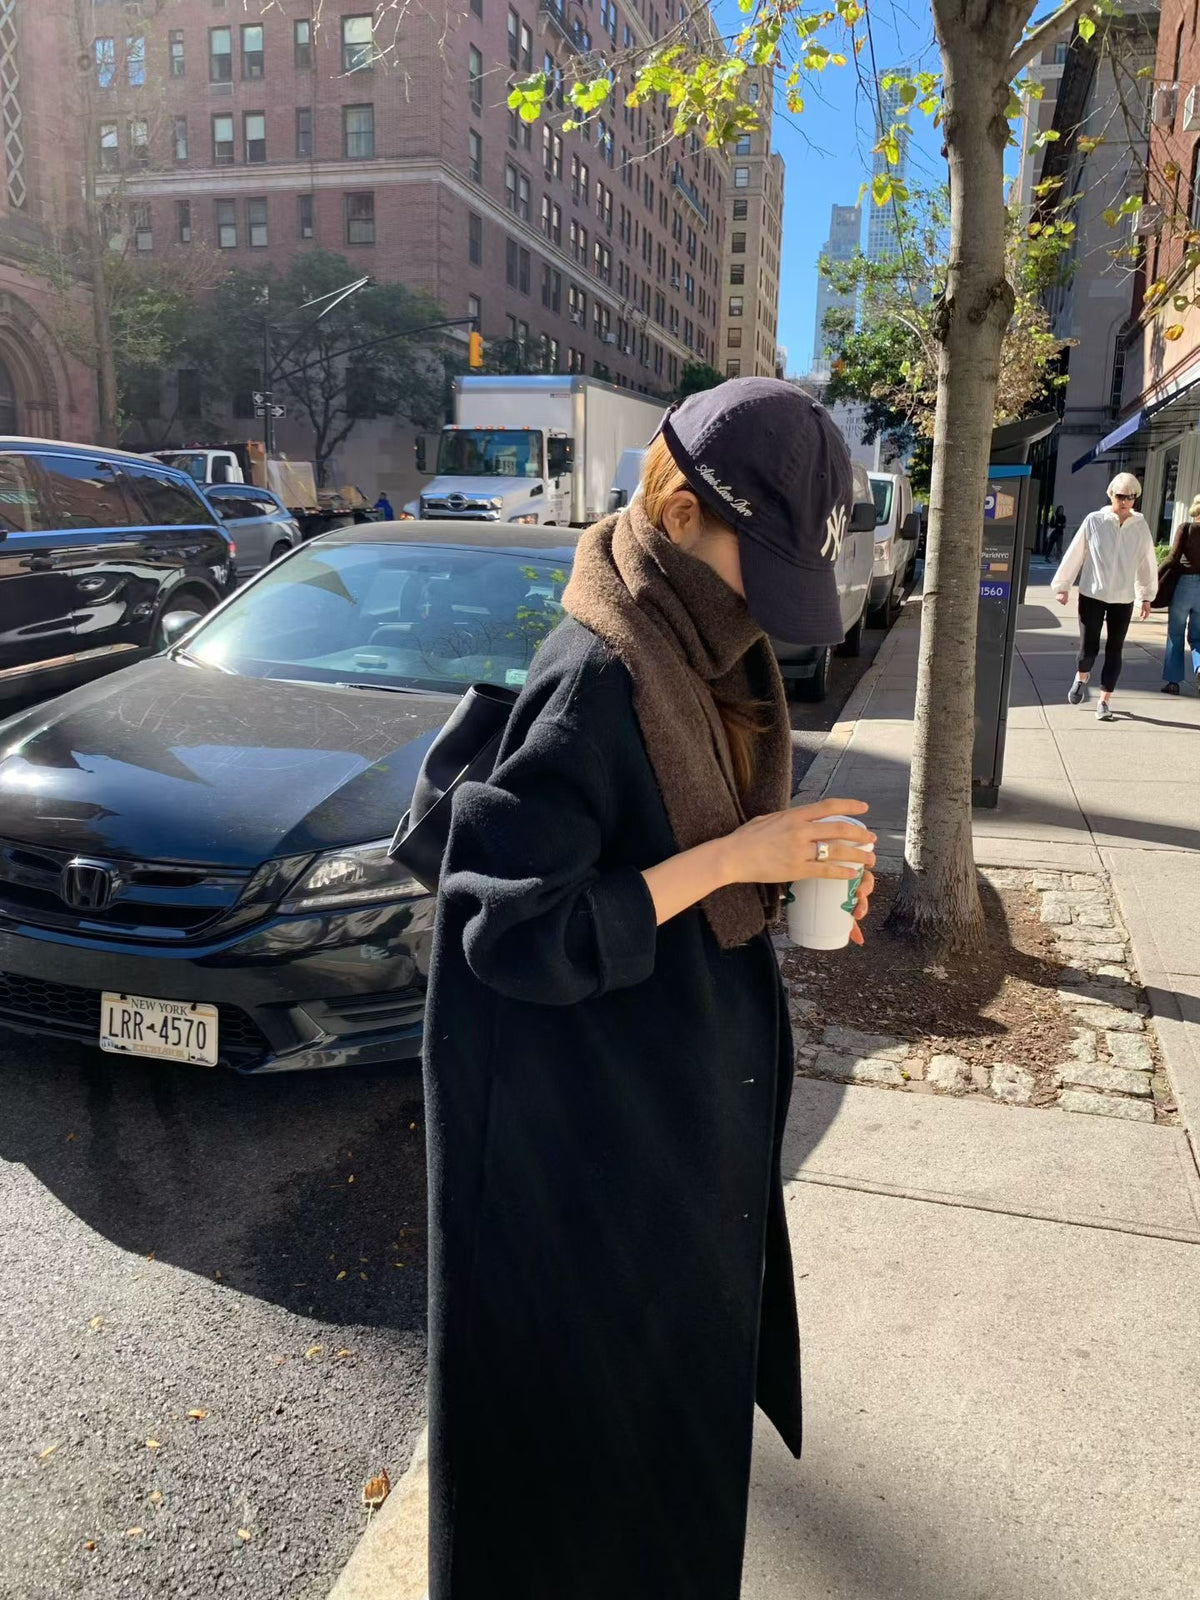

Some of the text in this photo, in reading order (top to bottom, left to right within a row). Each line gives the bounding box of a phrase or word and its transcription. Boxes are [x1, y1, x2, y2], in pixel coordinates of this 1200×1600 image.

[980, 586, 1003, 596] 1560
[131, 998, 189, 1016] NEW YORK
[108, 1007, 207, 1050] LRR 4570
